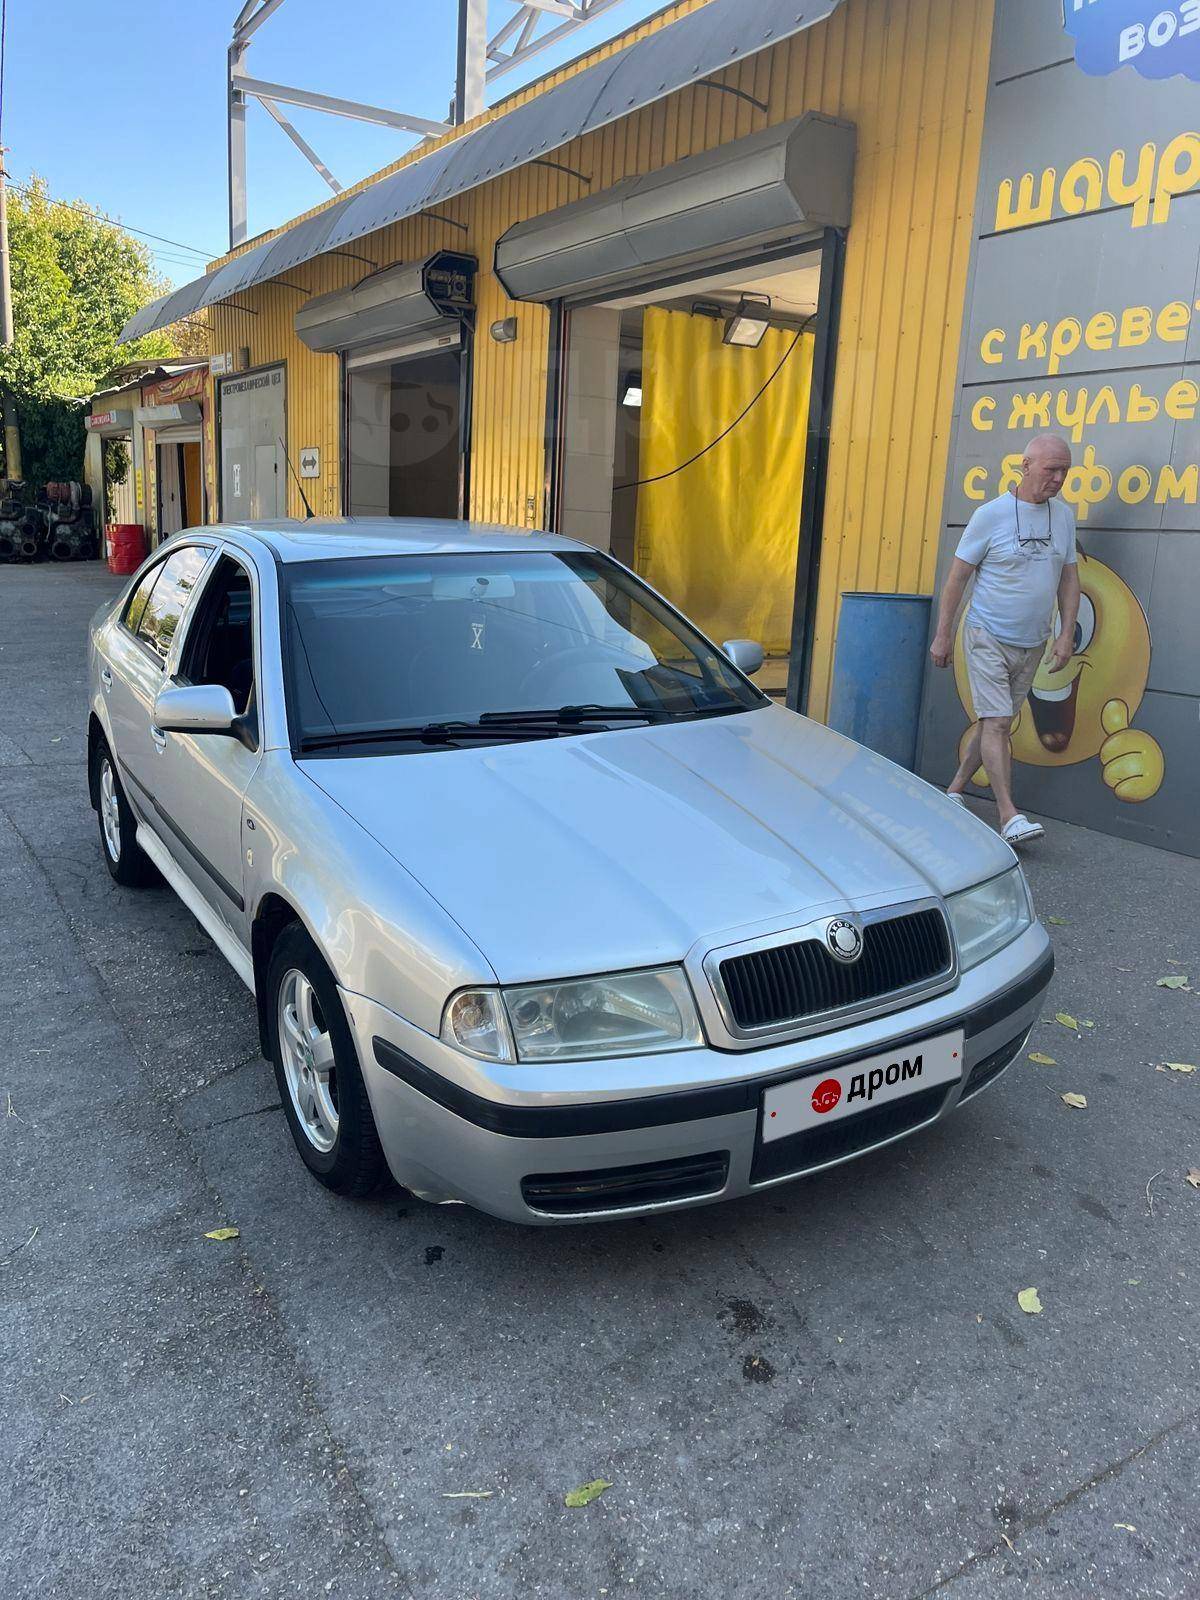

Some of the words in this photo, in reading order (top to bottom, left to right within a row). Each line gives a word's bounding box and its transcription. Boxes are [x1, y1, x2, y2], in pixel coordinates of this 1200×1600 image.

[980, 328, 1006, 364] с
[1017, 299, 1200, 375] креве
[971, 396, 996, 431] с
[1007, 379, 1199, 443] жулье
[963, 465, 988, 500] с
[998, 444, 1199, 520] бфом
